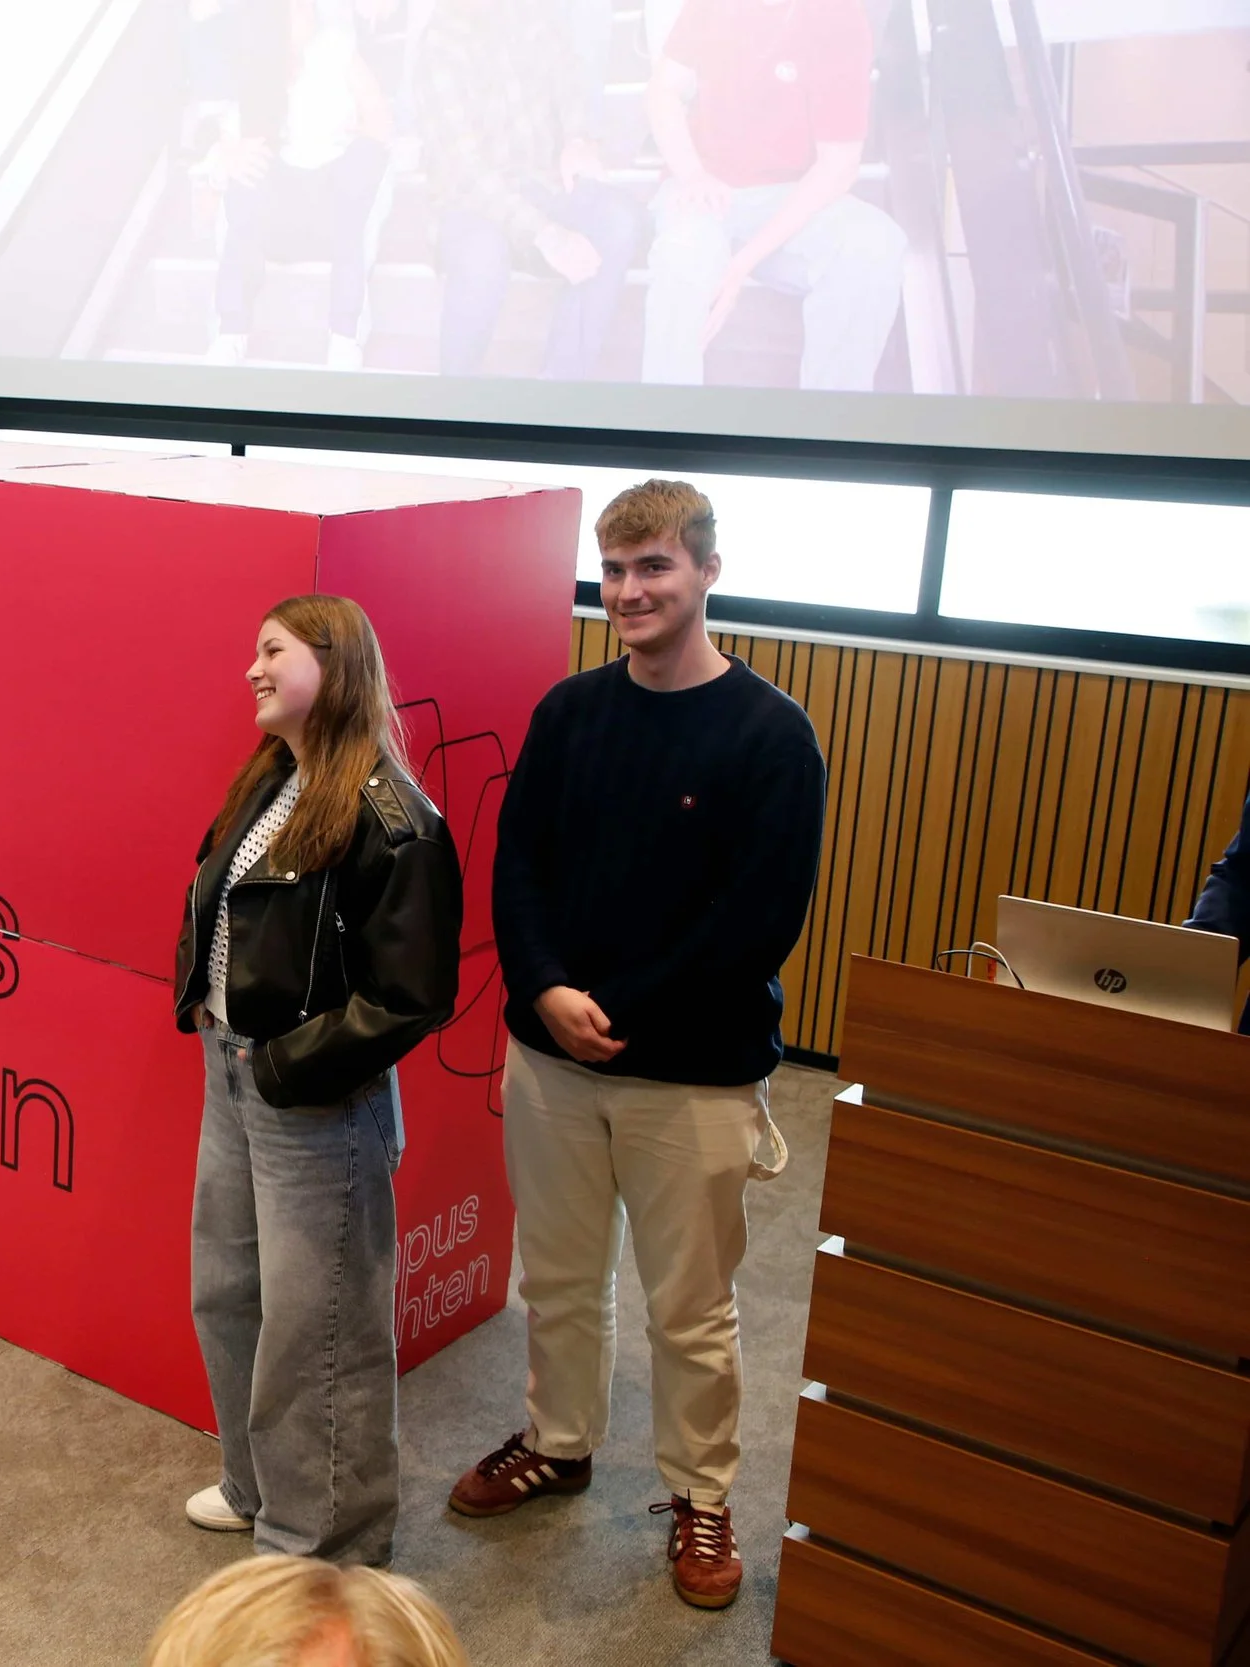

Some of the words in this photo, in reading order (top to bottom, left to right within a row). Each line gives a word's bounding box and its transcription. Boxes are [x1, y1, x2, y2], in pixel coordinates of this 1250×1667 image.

[1097, 968, 1124, 992] hp
[395, 1194, 479, 1283] pus
[395, 1253, 490, 1350] hten
